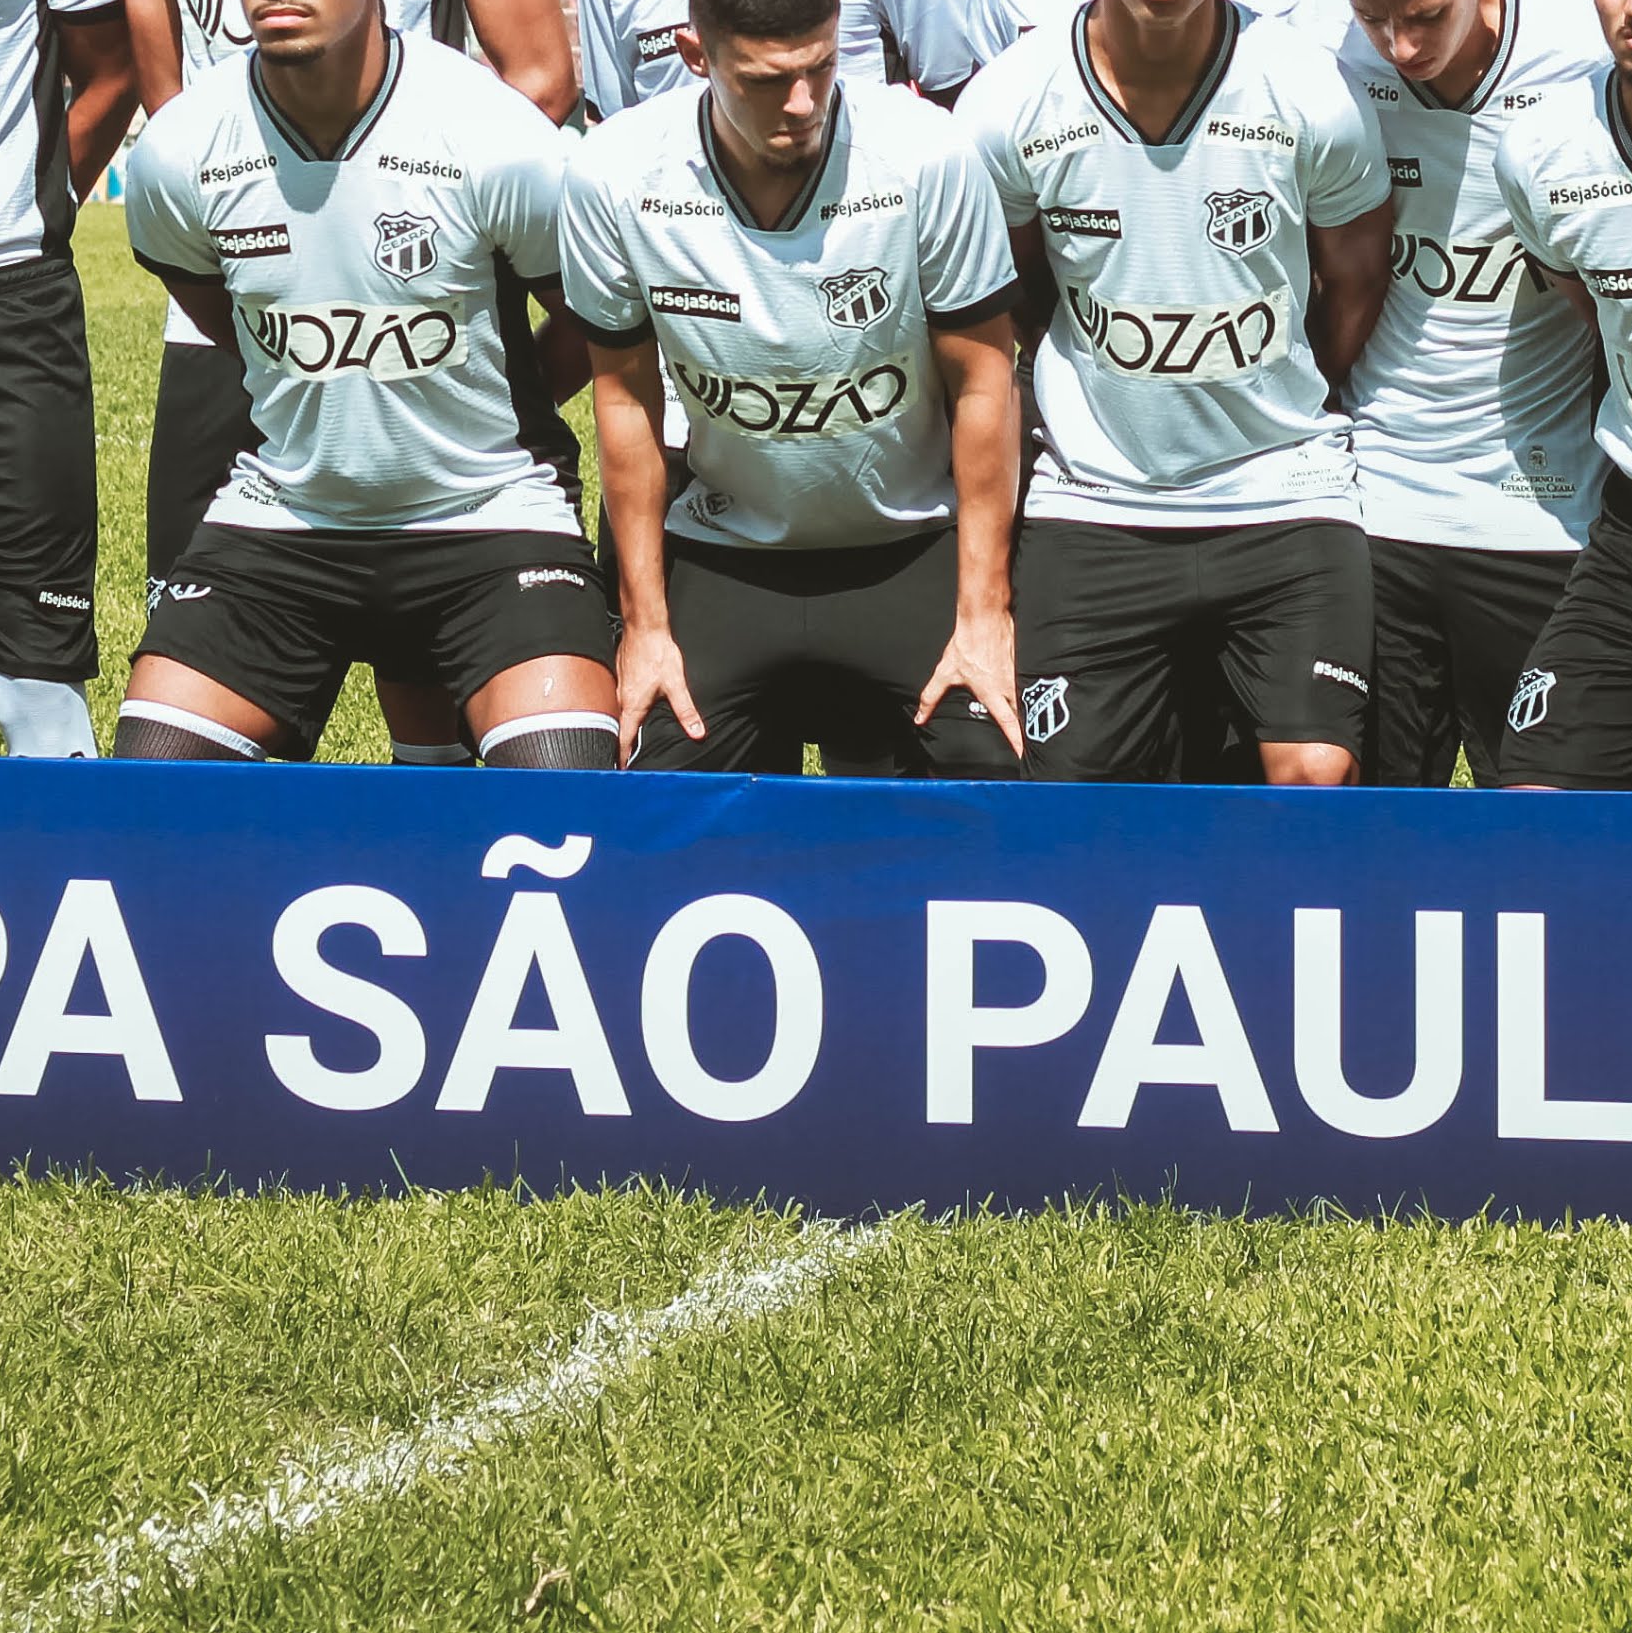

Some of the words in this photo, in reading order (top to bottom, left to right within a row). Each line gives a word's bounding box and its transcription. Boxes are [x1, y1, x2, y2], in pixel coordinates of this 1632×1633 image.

[1207, 120, 1295, 148] #SejaSócio
[378, 153, 462, 181] #SejaSócio
[641, 198, 725, 217] #SejaSócio
[820, 193, 903, 221] #SejaSócio
[652, 291, 740, 316] #SejaSócio
[265, 833, 826, 1123] SÃO
